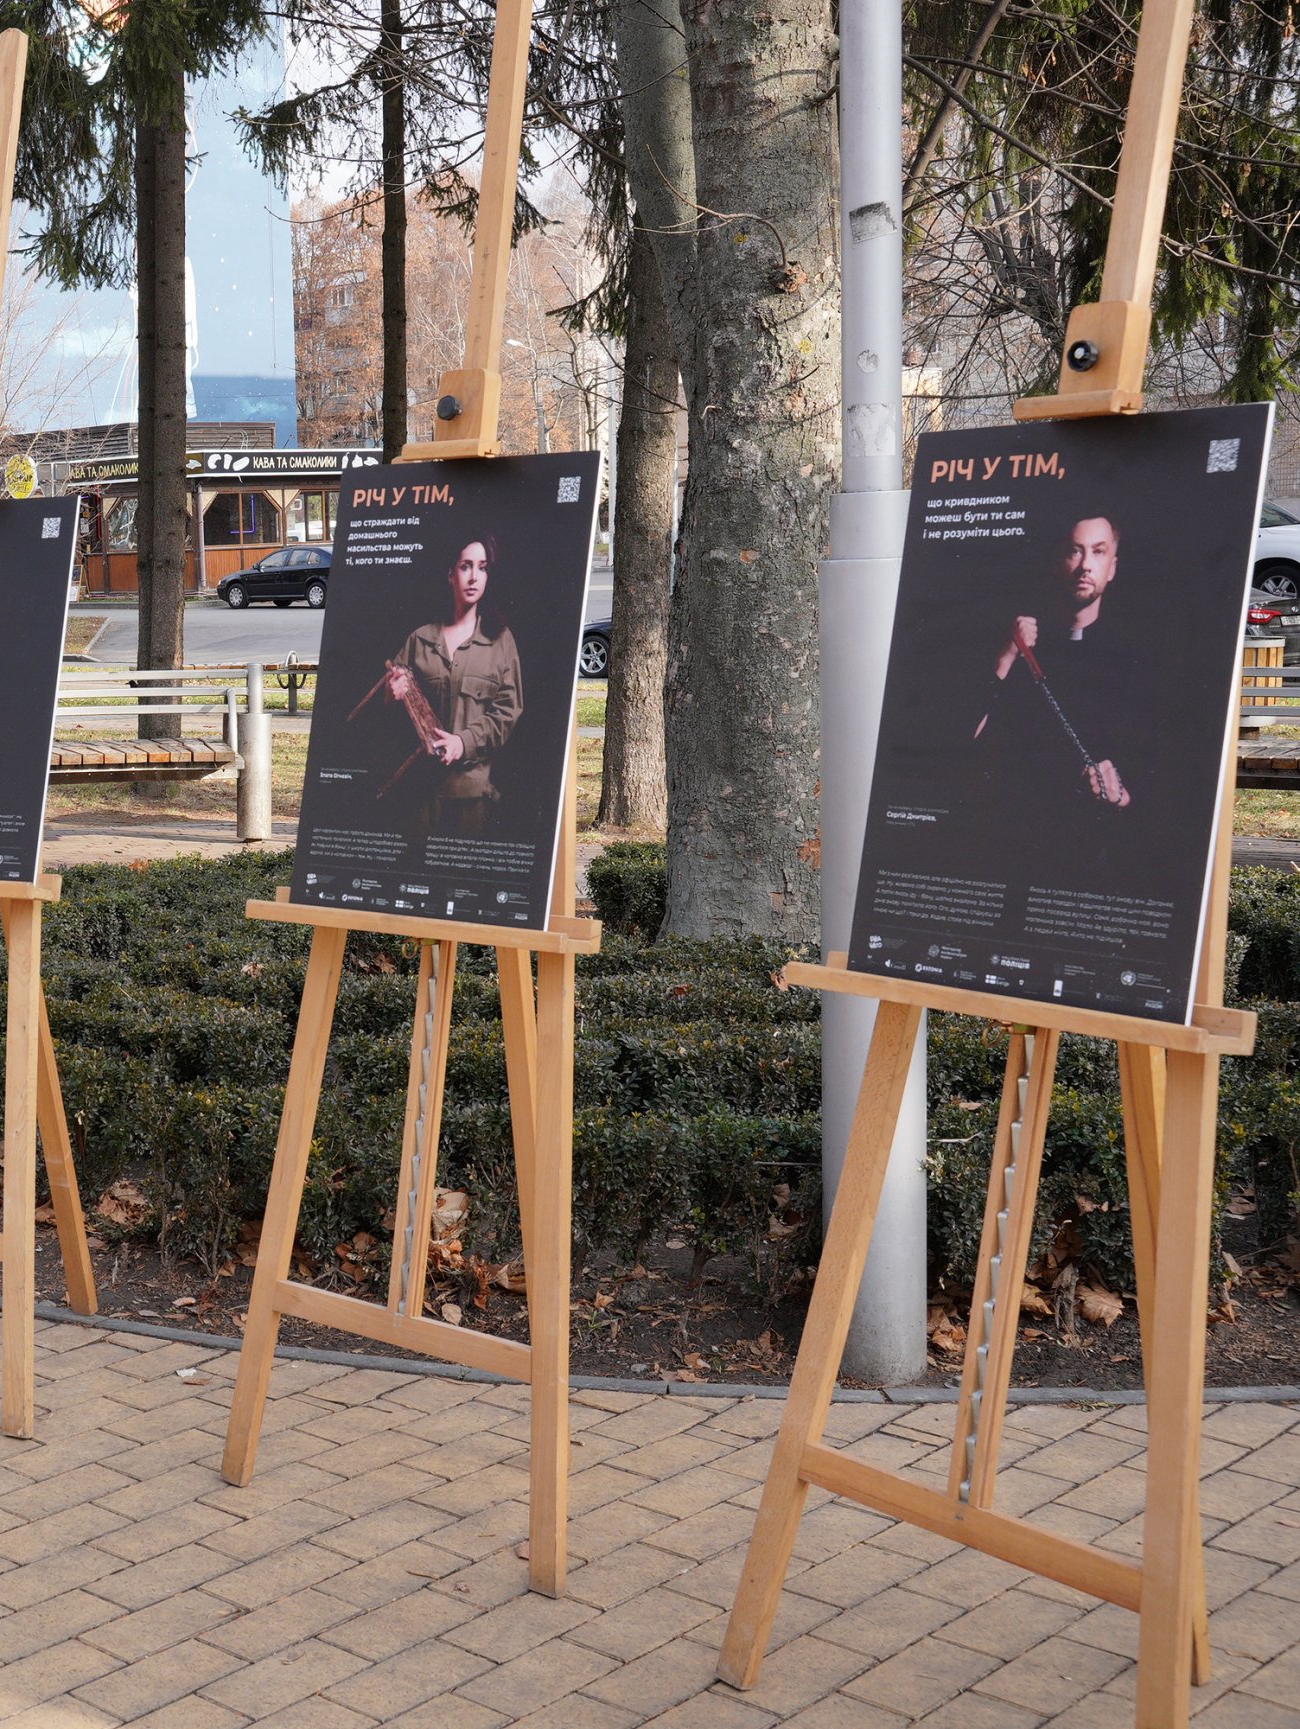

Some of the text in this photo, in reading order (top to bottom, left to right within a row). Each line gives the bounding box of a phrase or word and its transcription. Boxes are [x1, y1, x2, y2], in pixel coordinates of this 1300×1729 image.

[253, 455, 338, 469] КАВА ТА СМАКОЛИКИ
[930, 452, 1066, 483] РІЧ У ТІМ,
[87, 466, 97, 477] ТА
[99, 462, 139, 476] СМАКОЛИК
[352, 484, 454, 508] РІЧ У ТІМ,
[927, 495, 1010, 508] що кривдником
[350, 516, 420, 528] що страждати від
[925, 510, 1026, 524] можеш бути ти сам
[348, 531, 398, 540] домашнього
[922, 527, 1026, 540] і не розуміти цього.
[347, 543, 424, 553] насильства можуть
[345, 556, 413, 566] ті, кого ти знаєш.
